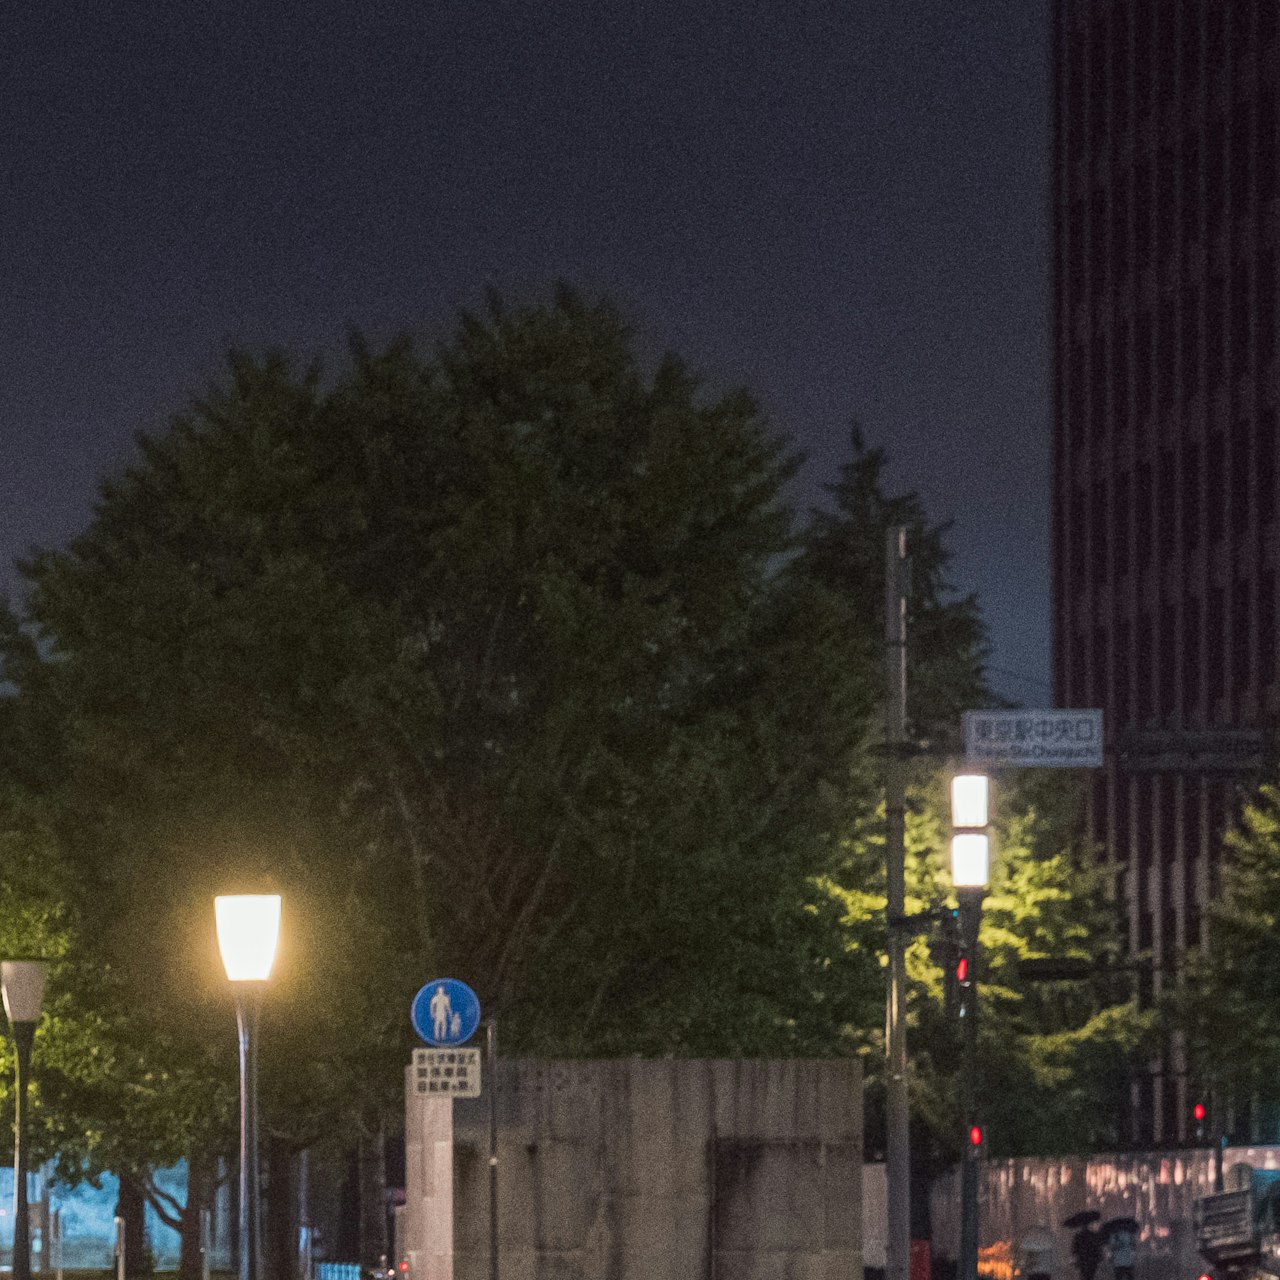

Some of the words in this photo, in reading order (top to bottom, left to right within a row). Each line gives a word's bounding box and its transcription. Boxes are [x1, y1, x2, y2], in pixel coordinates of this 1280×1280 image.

[975, 718, 1095, 741] 東京駅中央口
